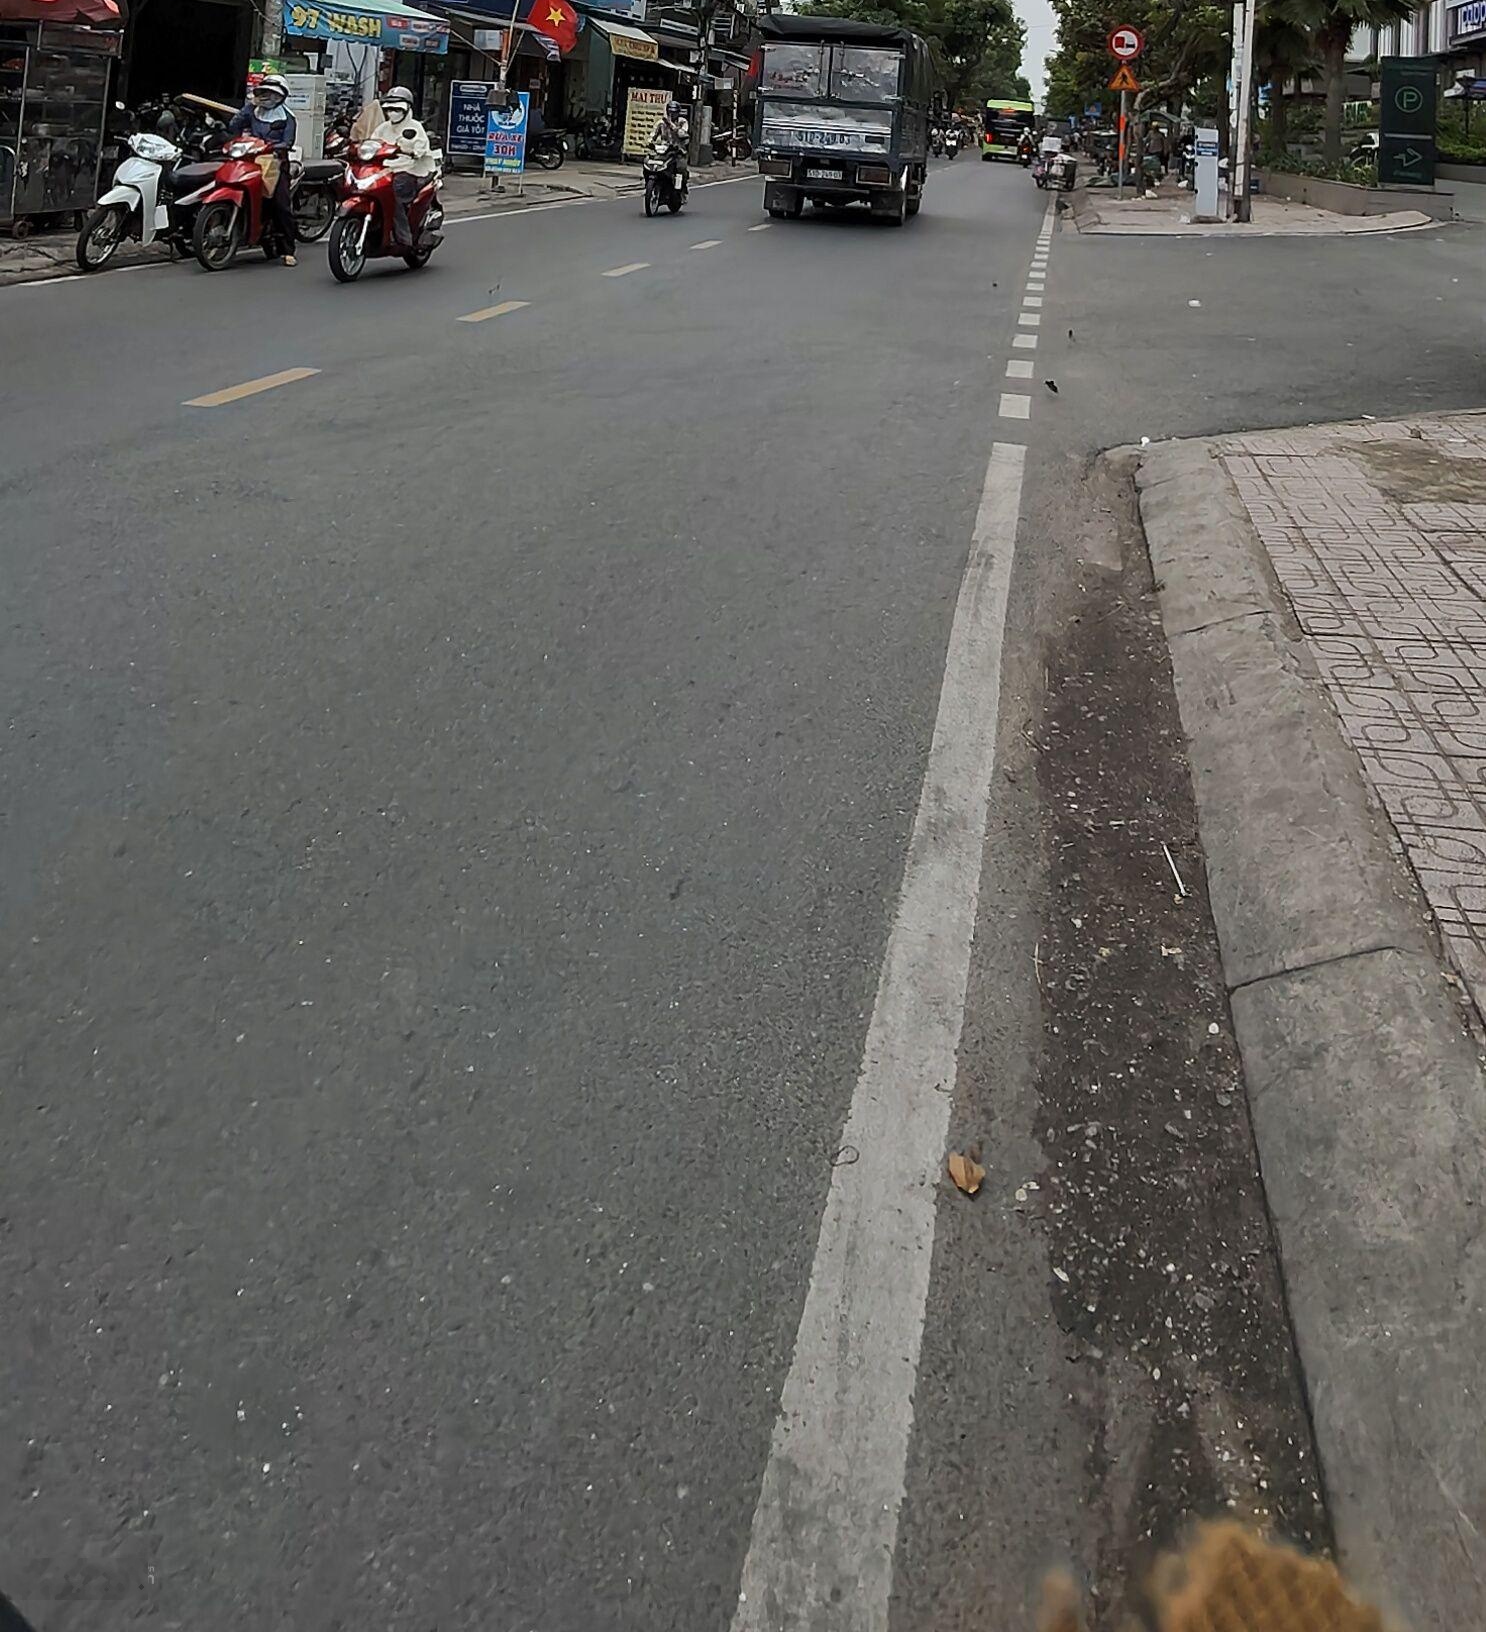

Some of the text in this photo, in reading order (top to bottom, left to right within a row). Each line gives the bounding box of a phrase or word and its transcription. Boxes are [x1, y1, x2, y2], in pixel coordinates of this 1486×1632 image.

[291, 5, 320, 29] 97
[327, 12, 382, 38] WASH
[458, 112, 486, 124] THUỐC
[456, 124, 471, 135] GIÁ
